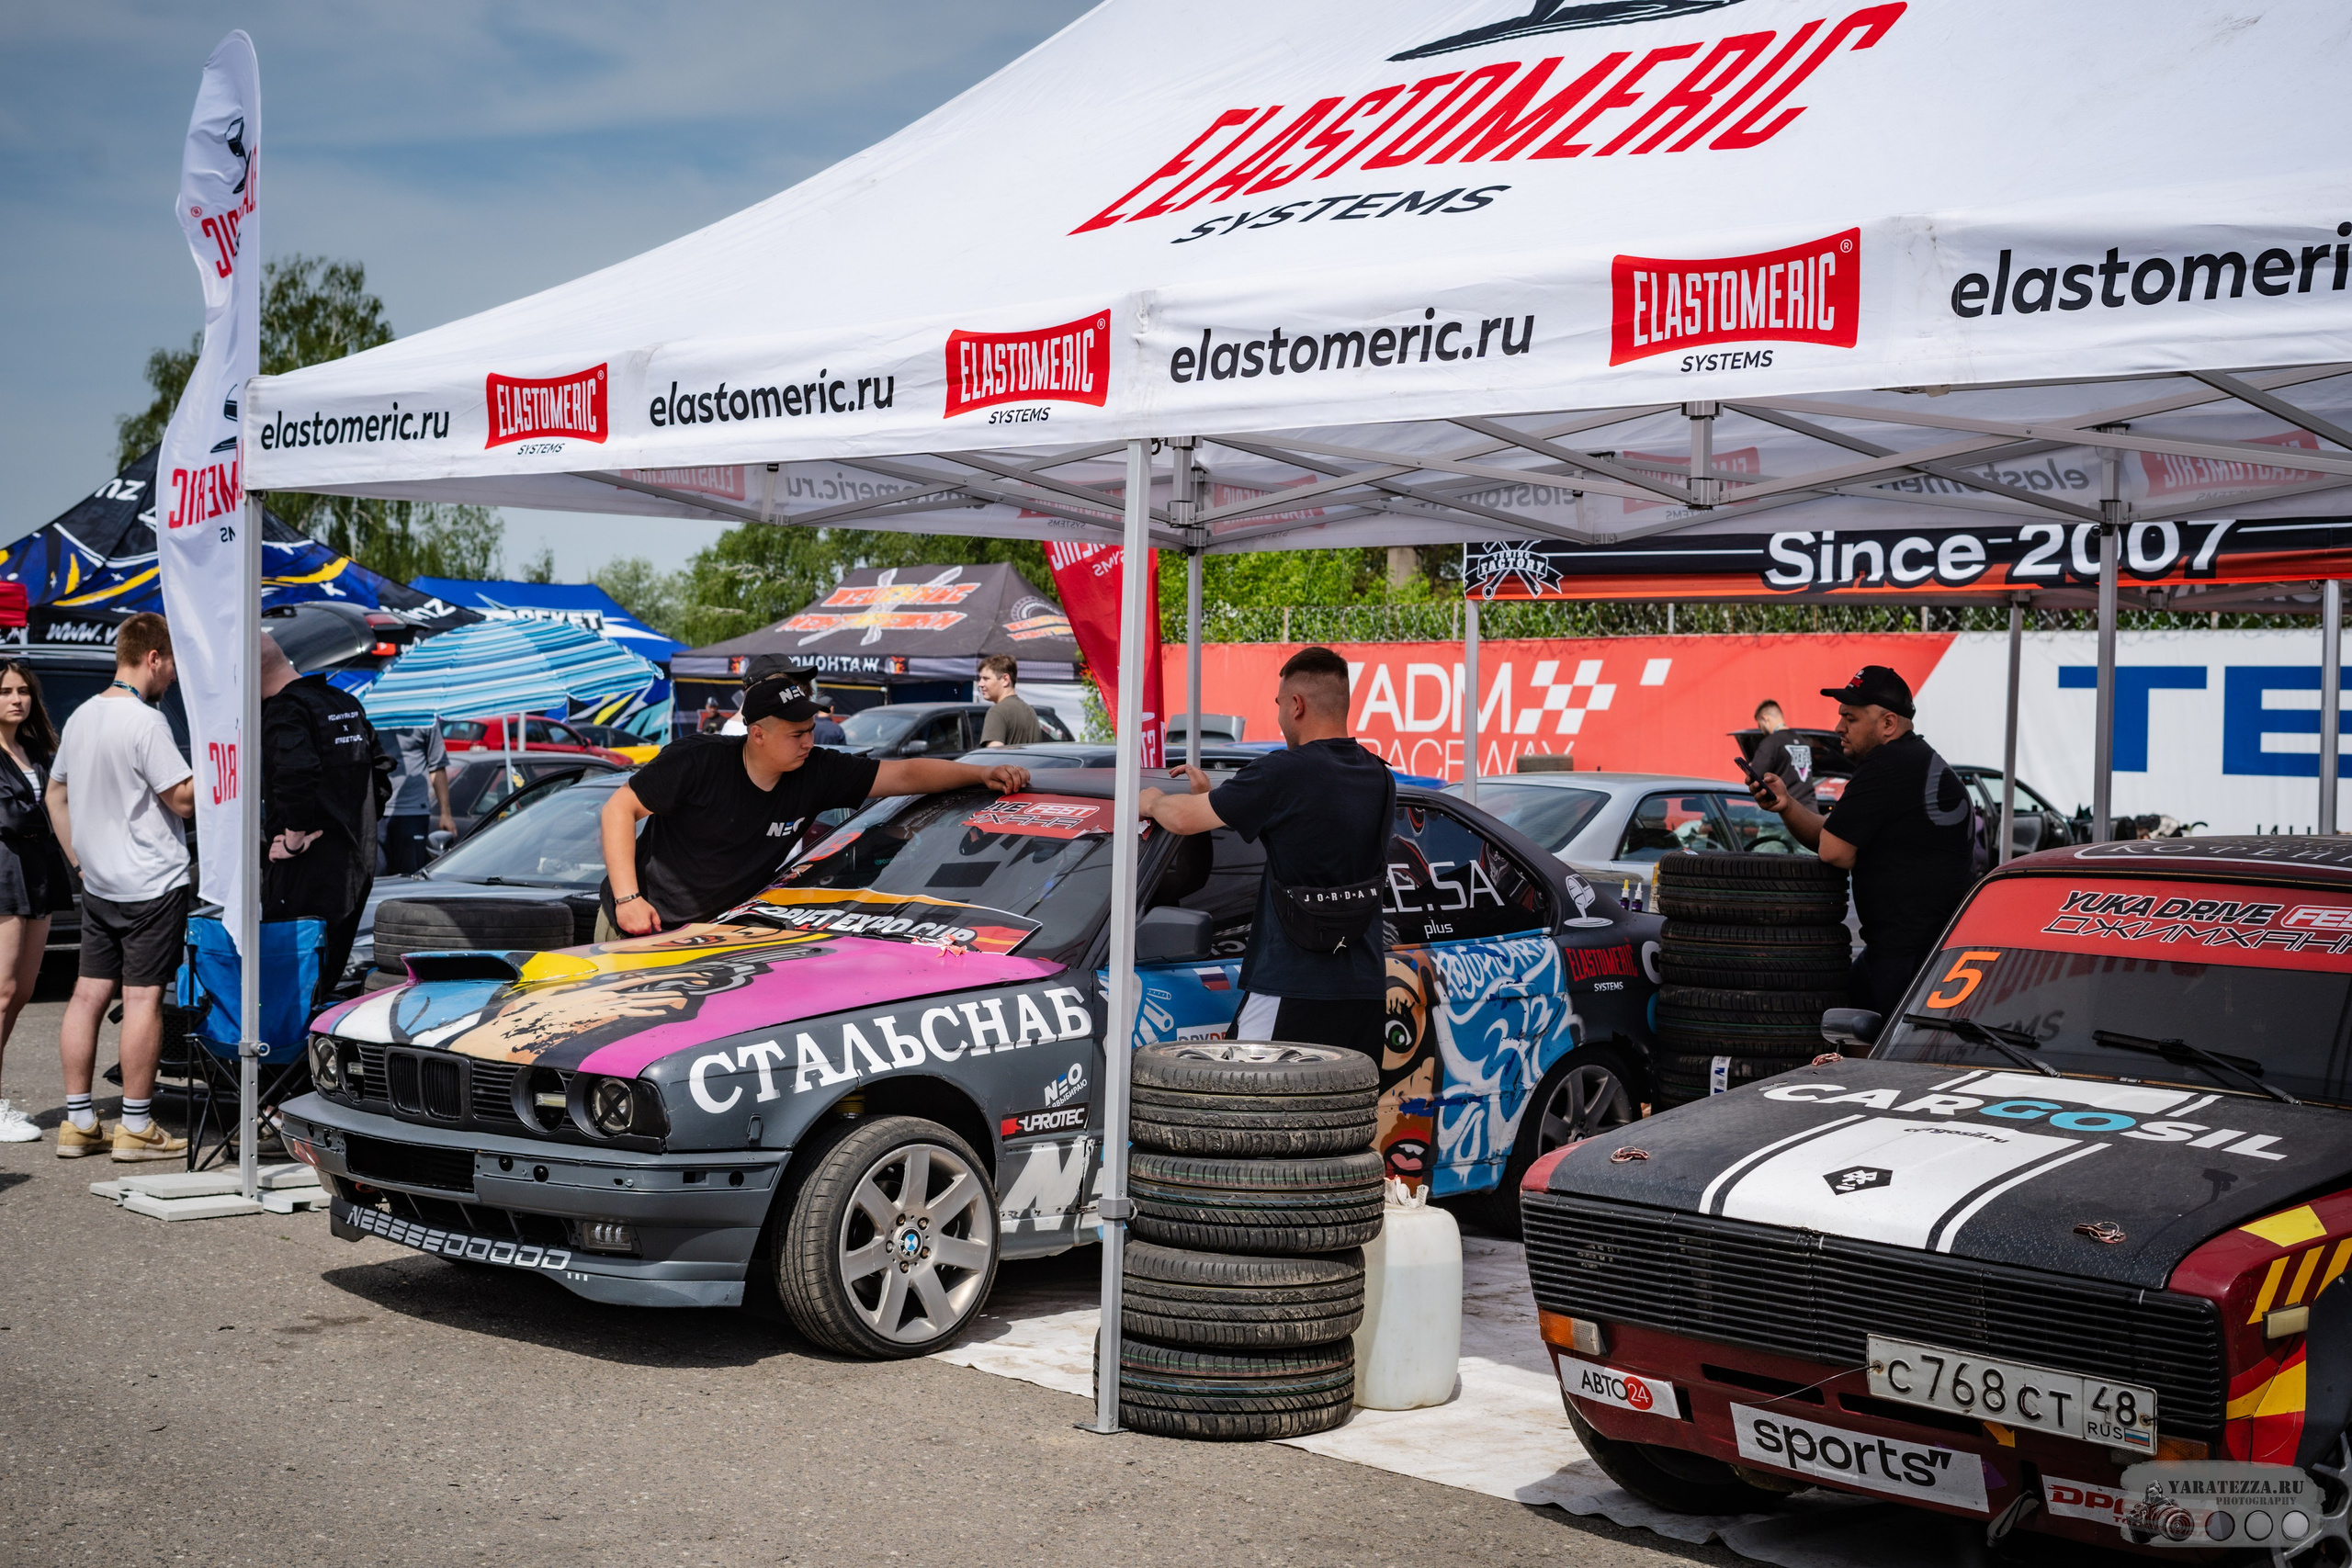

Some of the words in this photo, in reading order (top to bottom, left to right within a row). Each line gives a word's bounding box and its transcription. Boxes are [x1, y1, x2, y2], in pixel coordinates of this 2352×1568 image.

[1067, 1, 1907, 236] ELASTOMERIC
[1170, 186, 1512, 244] SYSTEMS
[1633, 252, 1837, 347] ELASTOMERIC
[959, 327, 1095, 403] ELASTOMERIC
[1170, 307, 1535, 385] elastomeric.ru
[1680, 349, 1774, 373] SYSTEMS
[496, 378, 598, 437] ELASTOMERIC
[650, 368, 895, 427] elastomeric.ru
[988, 407, 1051, 425] SYSTEMS
[261, 401, 449, 450] elastomeric.ru
[516, 443, 565, 456] SYSTEMS
[1480, 558, 1545, 574] FACTORY
[1492, 551, 1531, 561] TUNING
[1765, 530, 1986, 587] Since
[2012, 519, 2237, 578] 2007
[1356, 662, 1512, 733] ADM
[1026, 805, 1098, 817] FEST
[829, 913, 914, 933] EXPO
[2060, 891, 2155, 918] YUKA
[2153, 898, 2285, 926] DRIVE
[1424, 921, 1453, 939] plus
[2041, 915, 2352, 954] ДЖИМХАН
[1565, 943, 1639, 982] ELASTOMERIC
[1926, 951, 2001, 1009] 5
[1593, 981, 1624, 992] SYSTEMS
[688, 987, 1093, 1114] СТАЛЬСНАБ
[1044, 1062, 1083, 1107] NEO
[1763, 1084, 2288, 1160] CARGOSIL
[1904, 1127, 2010, 1144] cargosil.ru
[2091, 1385, 2136, 1427] 48
[2086, 1422, 2123, 1440] RUS
